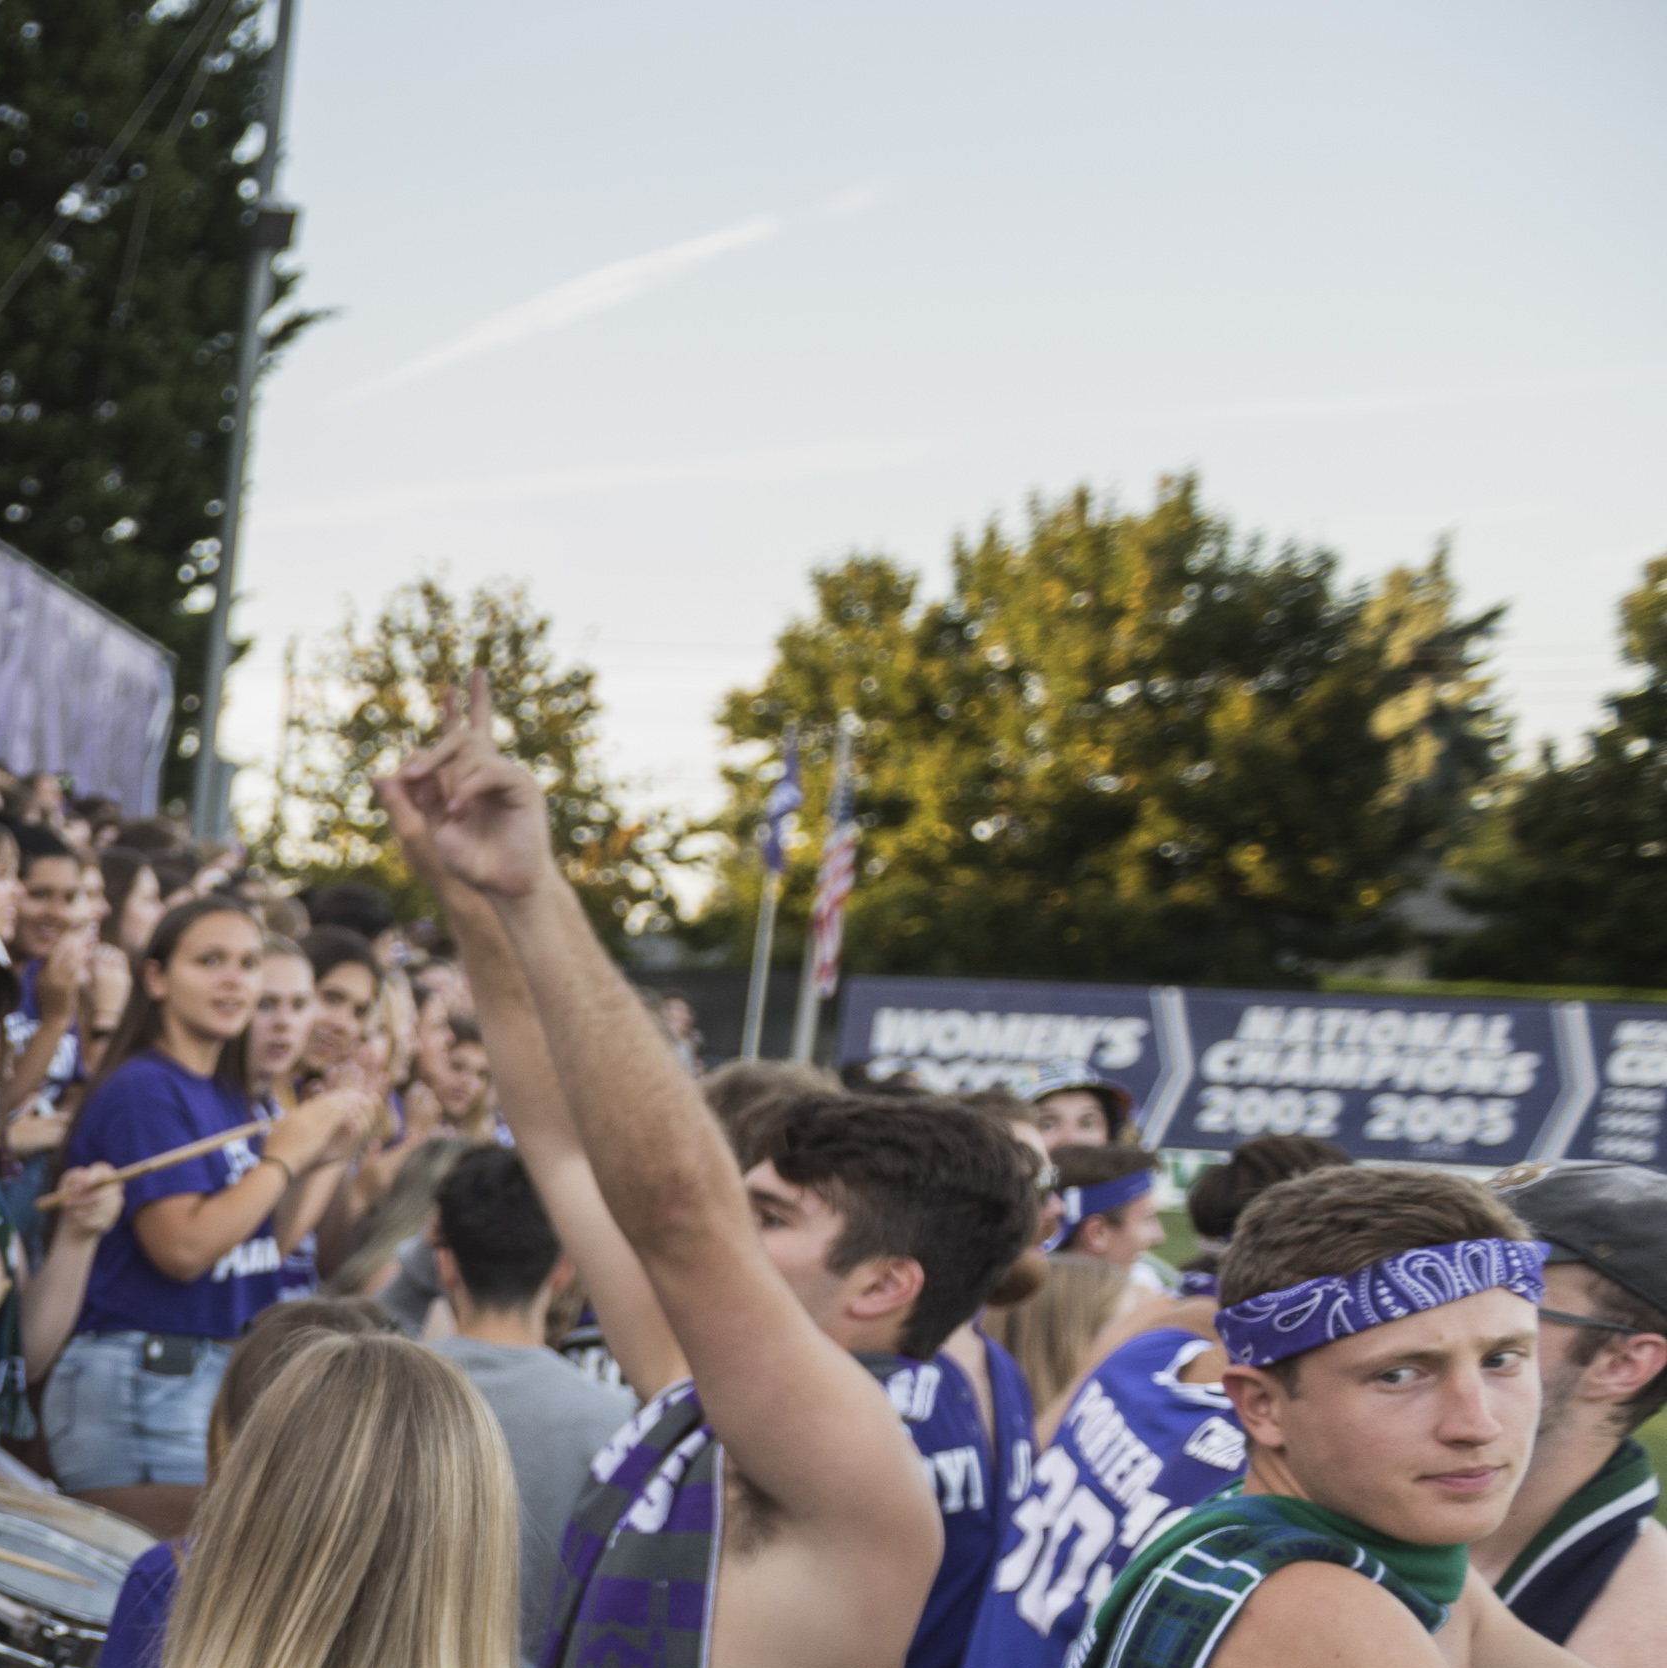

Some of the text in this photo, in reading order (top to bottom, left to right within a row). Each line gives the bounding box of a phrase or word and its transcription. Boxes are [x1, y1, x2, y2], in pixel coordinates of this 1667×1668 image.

[870, 1006, 1150, 1070] WOMEN'S
[1233, 1005, 1515, 1057] NATIONAL
[1199, 1039, 1543, 1096] CHAMPIONS
[1194, 1085, 1518, 1146] 2002 2005
[1068, 1379, 1165, 1505] PORTER
